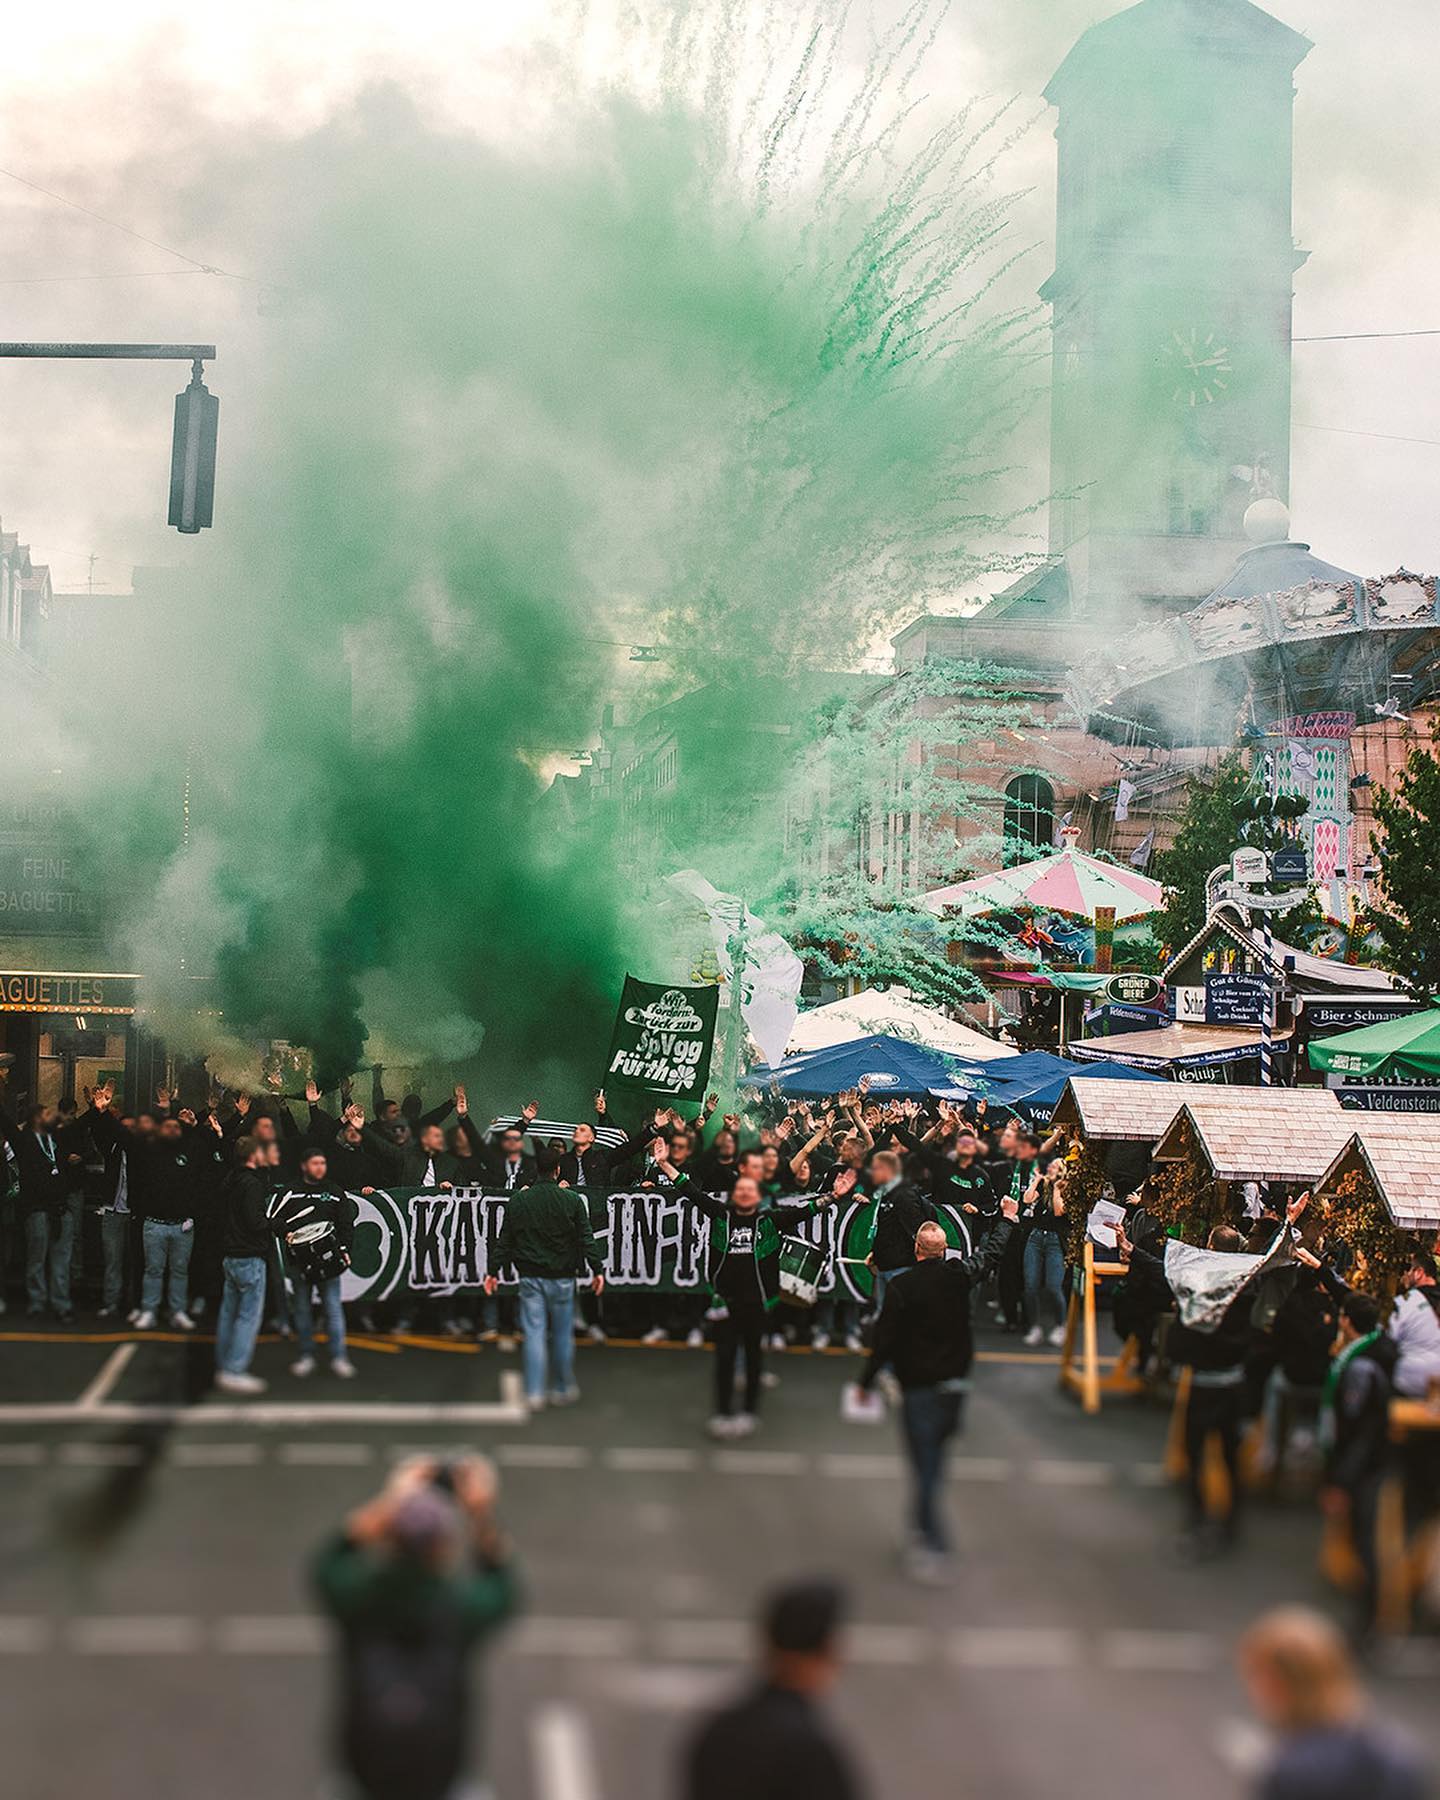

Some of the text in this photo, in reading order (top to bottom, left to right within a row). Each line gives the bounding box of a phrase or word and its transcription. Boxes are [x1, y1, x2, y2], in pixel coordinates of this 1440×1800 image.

[1123, 989, 1145, 998] BIERE
[1321, 1010, 1345, 1021] Bier
[609, 1050, 670, 1082] Fürth
